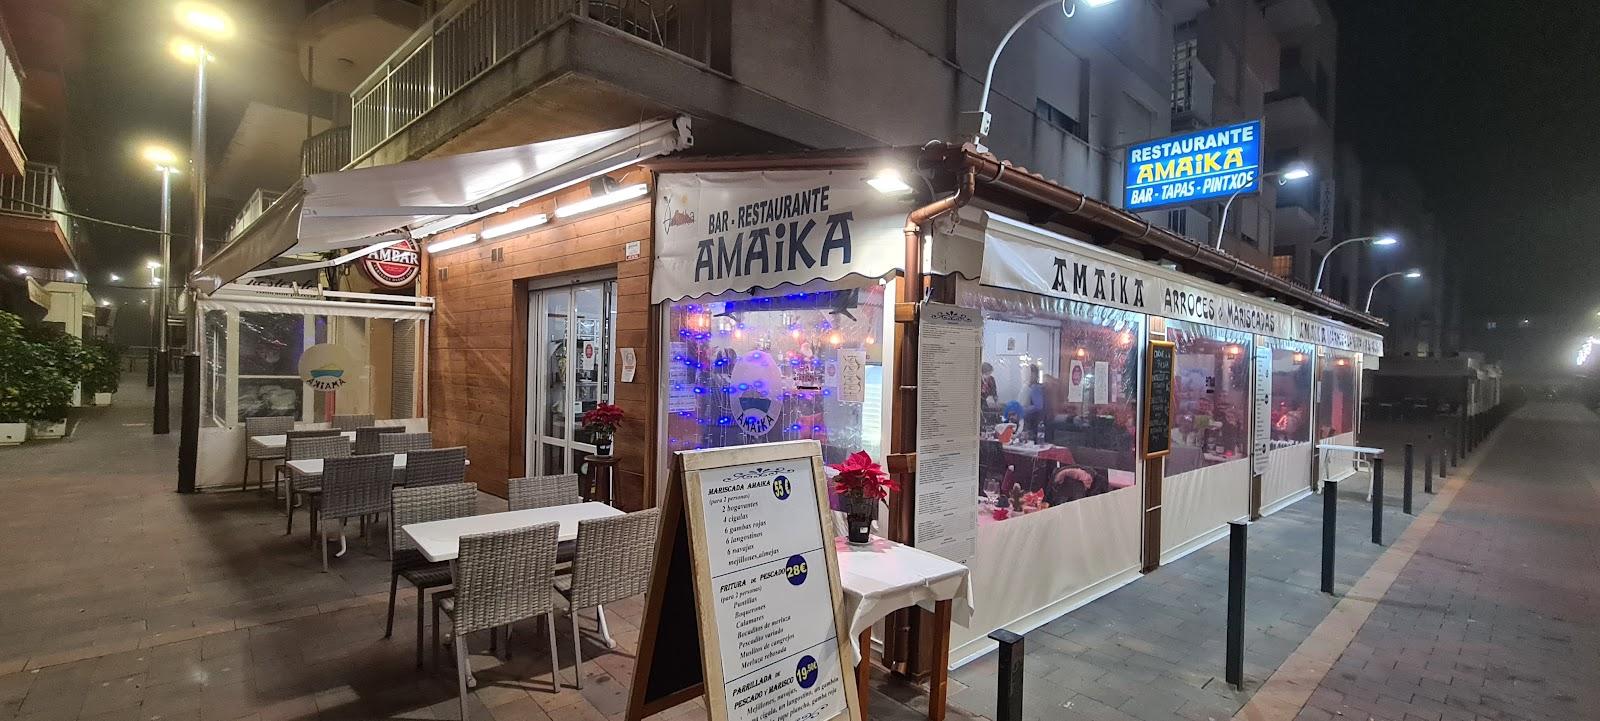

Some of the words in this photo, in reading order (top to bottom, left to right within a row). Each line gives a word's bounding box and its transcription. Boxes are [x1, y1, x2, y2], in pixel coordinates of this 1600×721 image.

[1131, 125, 1254, 163] RESTAURANTE
[1130, 187, 1154, 204] BAR
[1161, 181, 1196, 200] TAPAS
[1202, 170, 1254, 194] PINTXOS
[708, 213, 729, 235] BAR
[738, 185, 830, 229] RESTAURANTE
[367, 248, 418, 265] AMBAR
[1164, 287, 1215, 321] ARROCES
[1226, 302, 1275, 332] MARISCADAS
[708, 484, 745, 496] MARISCADA
[747, 480, 771, 489] AMAIKA
[727, 501, 759, 512] bogavantes
[728, 513, 748, 523] cigalas
[729, 523, 752, 535] gambas
[752, 520, 767, 529] rojas
[730, 532, 763, 545] langostinos
[732, 544, 754, 554] navajas
[786, 562, 807, 578] 28€
[720, 579, 746, 593] FRITURA
[760, 567, 785, 581] PESCADO
[733, 597, 757, 609] Puntillas
[735, 604, 766, 619] Boquerones
[736, 615, 764, 629] Calamares
[764, 621, 770, 630] de
[771, 615, 791, 627] merluza
[738, 635, 764, 649] Pescadito
[763, 642, 770, 650] de
[771, 633, 795, 647] cangrejos
[741, 655, 764, 669] Merluza
[732, 673, 772, 697] PARRILLADA
[734, 690, 763, 710] PESCADO
[768, 676, 794, 694] MARISCO
[778, 703, 786, 711] un
